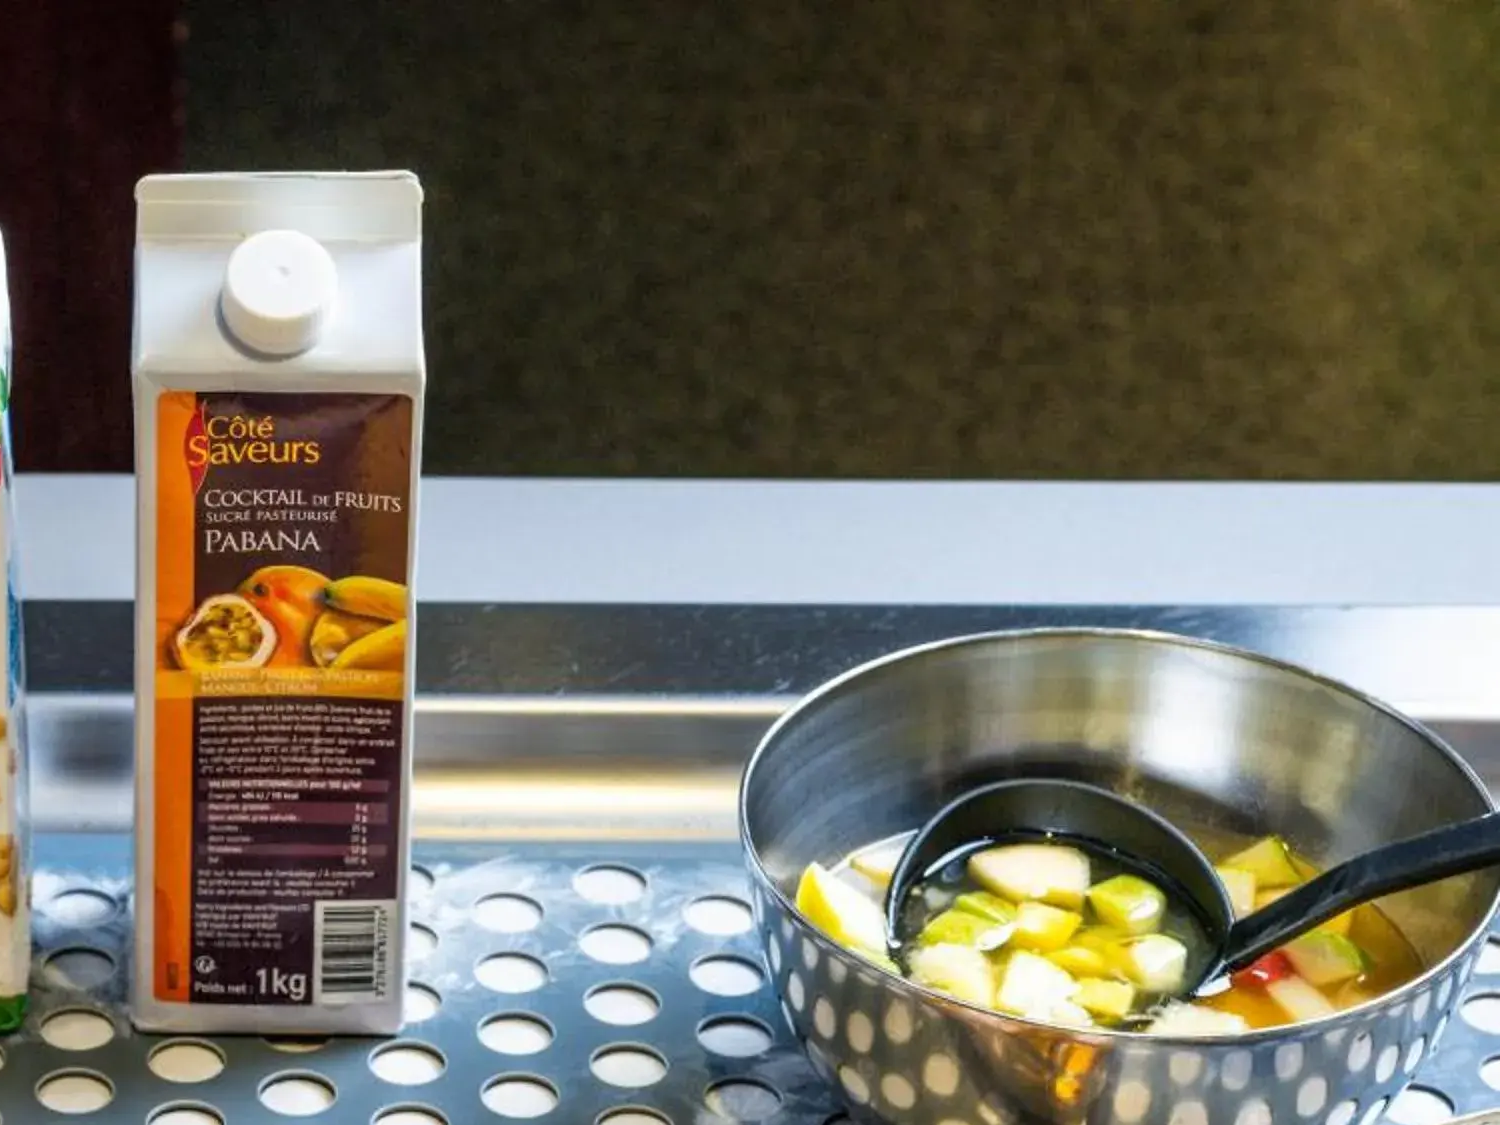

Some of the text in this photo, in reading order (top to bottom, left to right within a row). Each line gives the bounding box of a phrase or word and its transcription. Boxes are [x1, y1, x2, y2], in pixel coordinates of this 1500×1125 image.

[208, 415, 275, 440] Côté
[189, 435, 321, 465] Saveurs
[204, 489, 307, 508] COCKTAIL
[335, 491, 401, 512] FRUITS
[205, 529, 322, 553] PABANA
[256, 967, 307, 1001] 1kg
